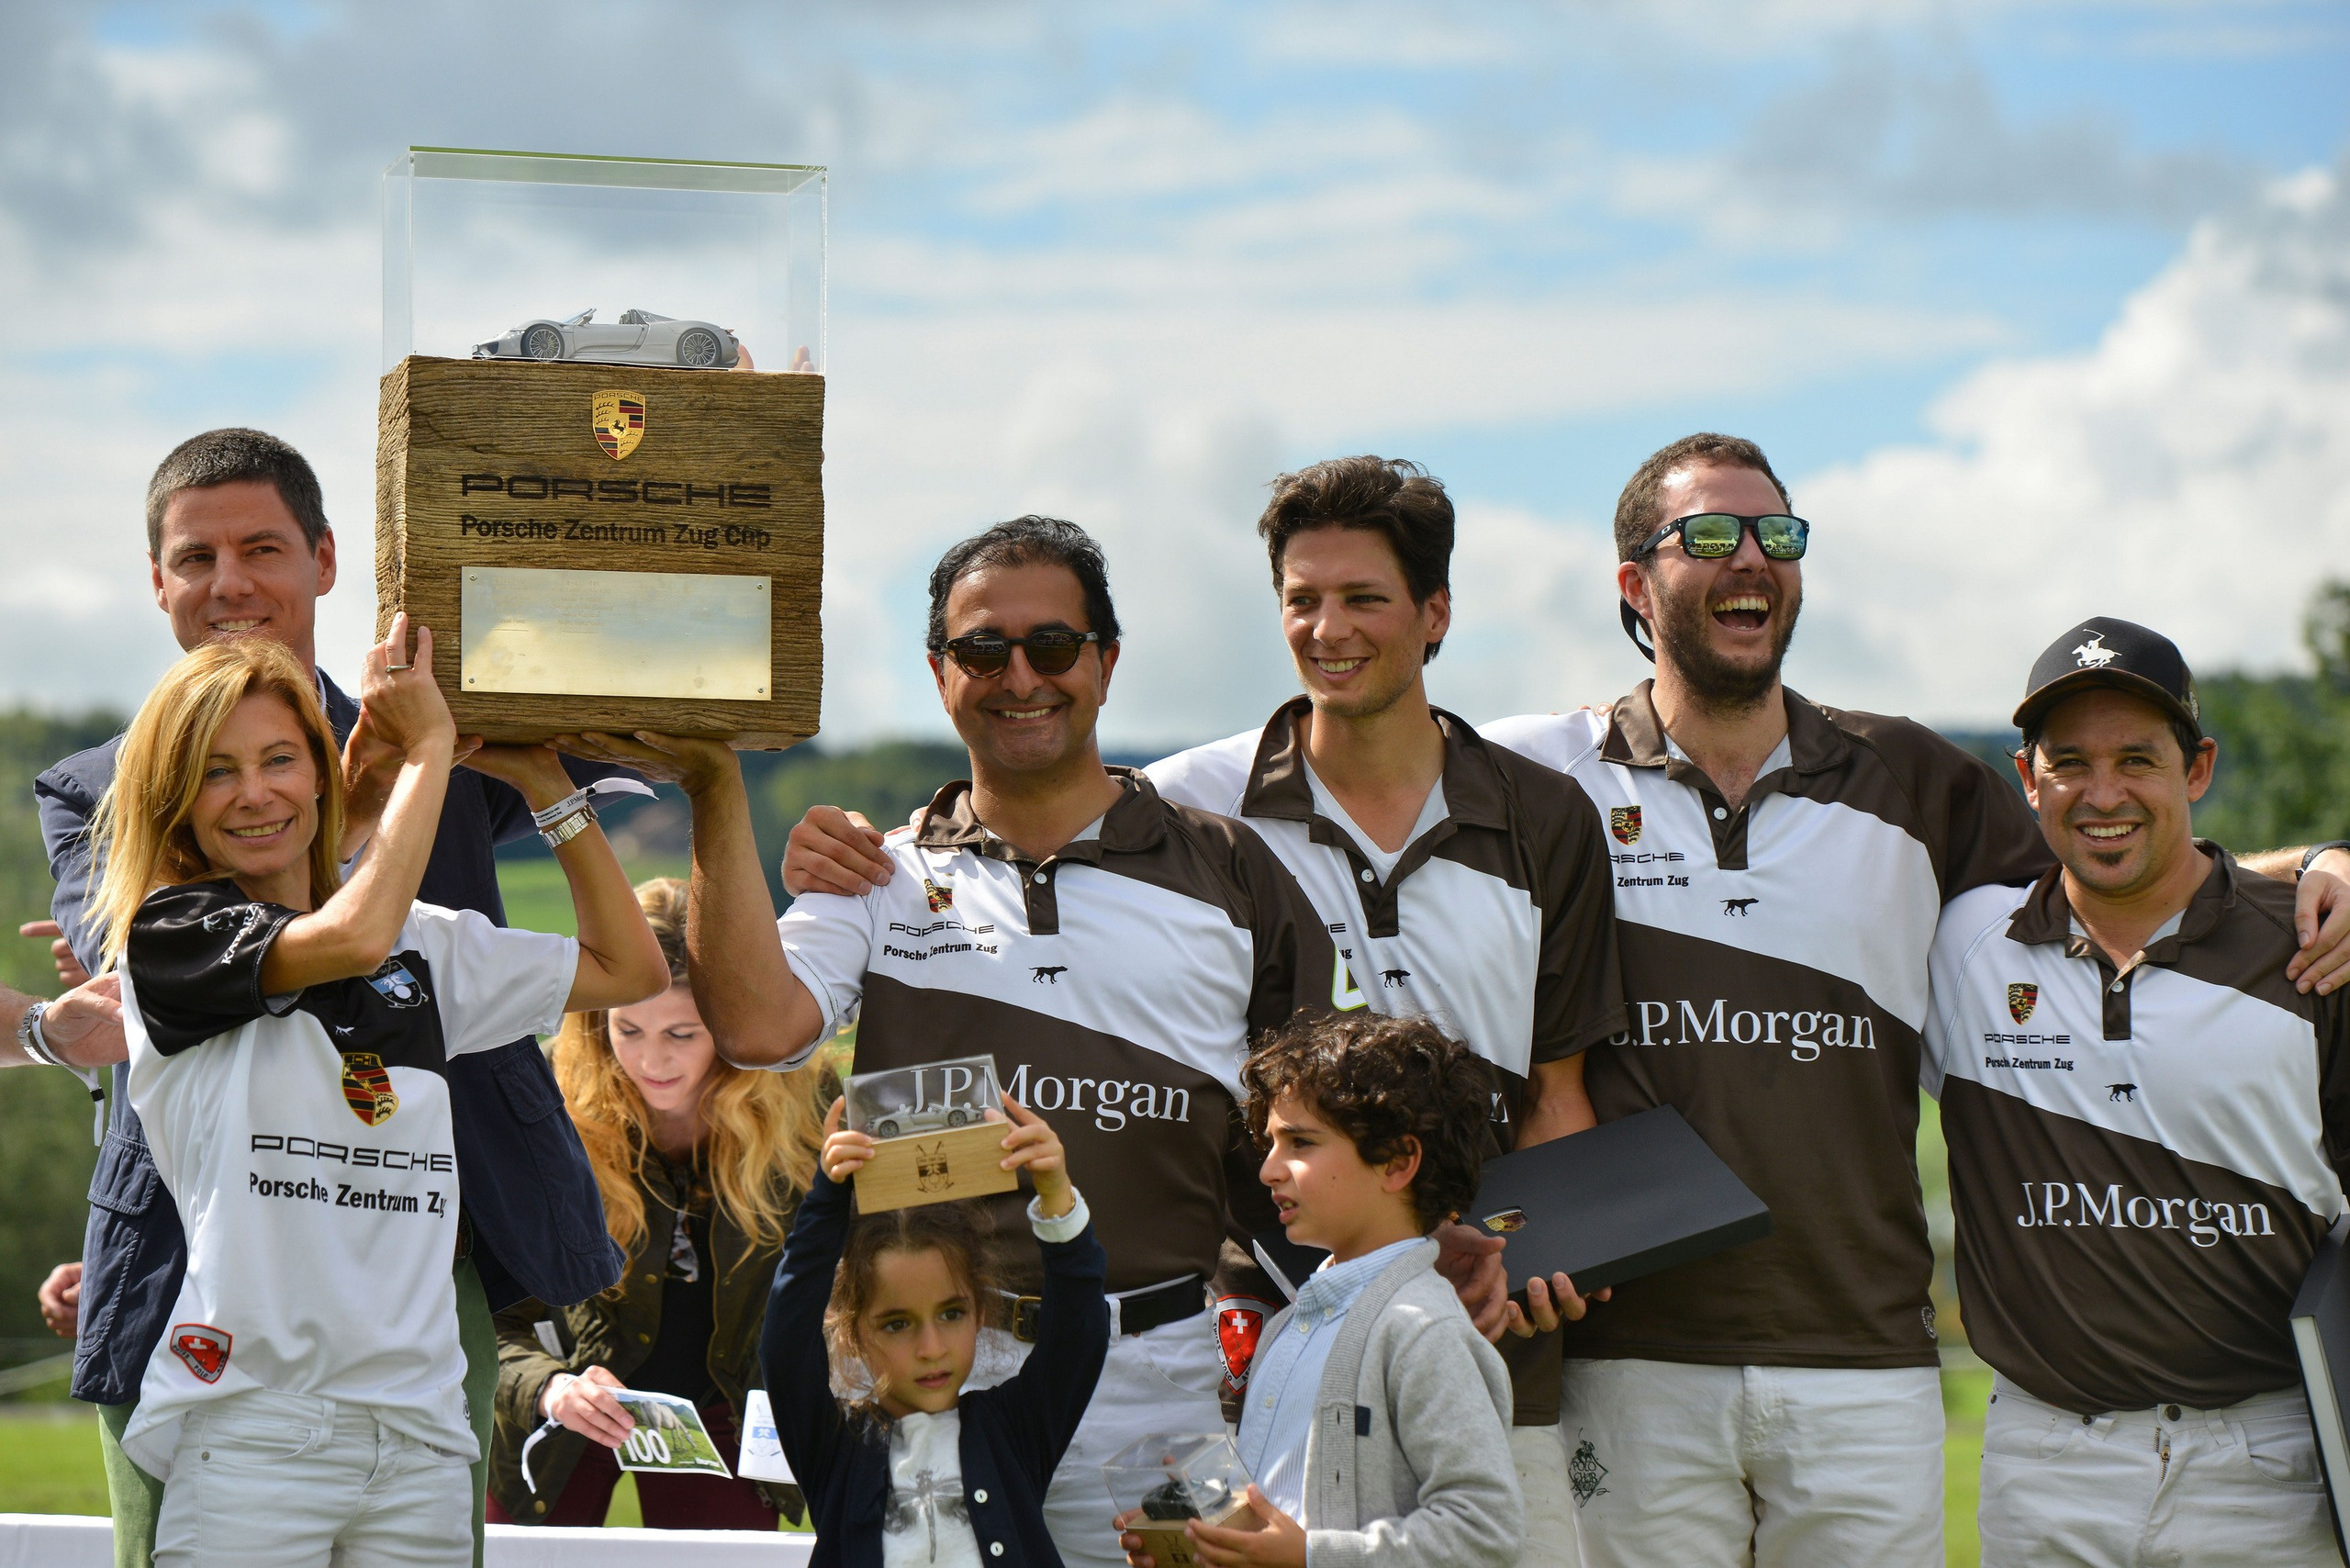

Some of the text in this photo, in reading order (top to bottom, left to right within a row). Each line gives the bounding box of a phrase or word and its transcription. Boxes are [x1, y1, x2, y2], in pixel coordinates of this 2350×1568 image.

[594, 392, 644, 403] PORSCHE
[461, 474, 771, 508] PORSCHE
[461, 514, 771, 551] Porsche Zentrum Zug Cup
[1610, 852, 1685, 864] RSCHE
[1617, 875, 1689, 888] Zentrum Zug
[883, 945, 928, 961] Porsche
[976, 943, 998, 954] Zug
[1984, 1034, 2071, 1044] PORSCHE
[2012, 1058, 2051, 1070] Zentrum
[2054, 1058, 2074, 1071] Zug
[899, 1064, 1190, 1132] J.P.Morgan
[252, 1134, 453, 1173] PORSCHE
[250, 1171, 329, 1204] Porsche
[335, 1183, 419, 1213] Zentrum
[2017, 1182, 2277, 1248] J.P.Morgan
[194, 1364, 208, 1378] POLO
[1221, 1361, 1233, 1382] POLO
[622, 1428, 671, 1464] 100
[1572, 1461, 1597, 1472] POLO
